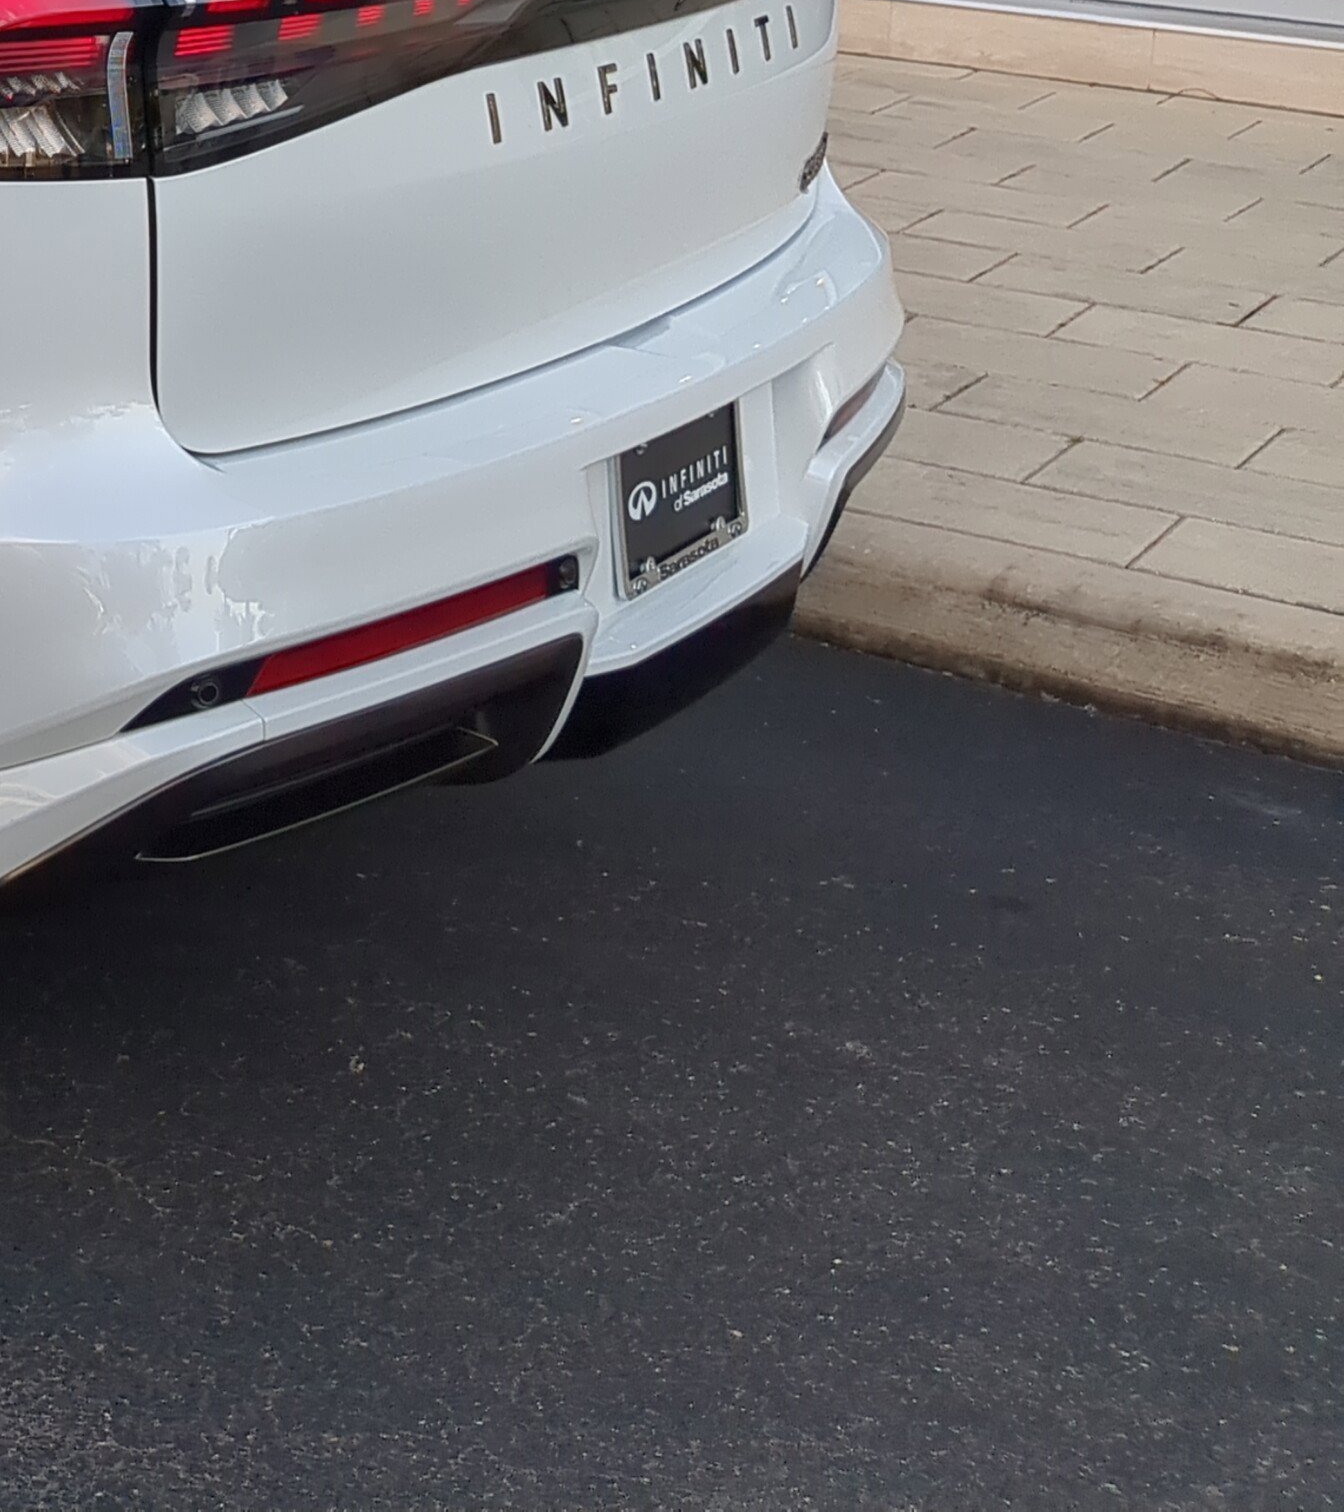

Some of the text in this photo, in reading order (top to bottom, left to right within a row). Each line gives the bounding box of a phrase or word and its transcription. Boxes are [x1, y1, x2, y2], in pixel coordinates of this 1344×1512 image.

[486, 4, 798, 145] INFINITI
[662, 445, 728, 500] INFINITI
[659, 537, 720, 581] Sarasota
